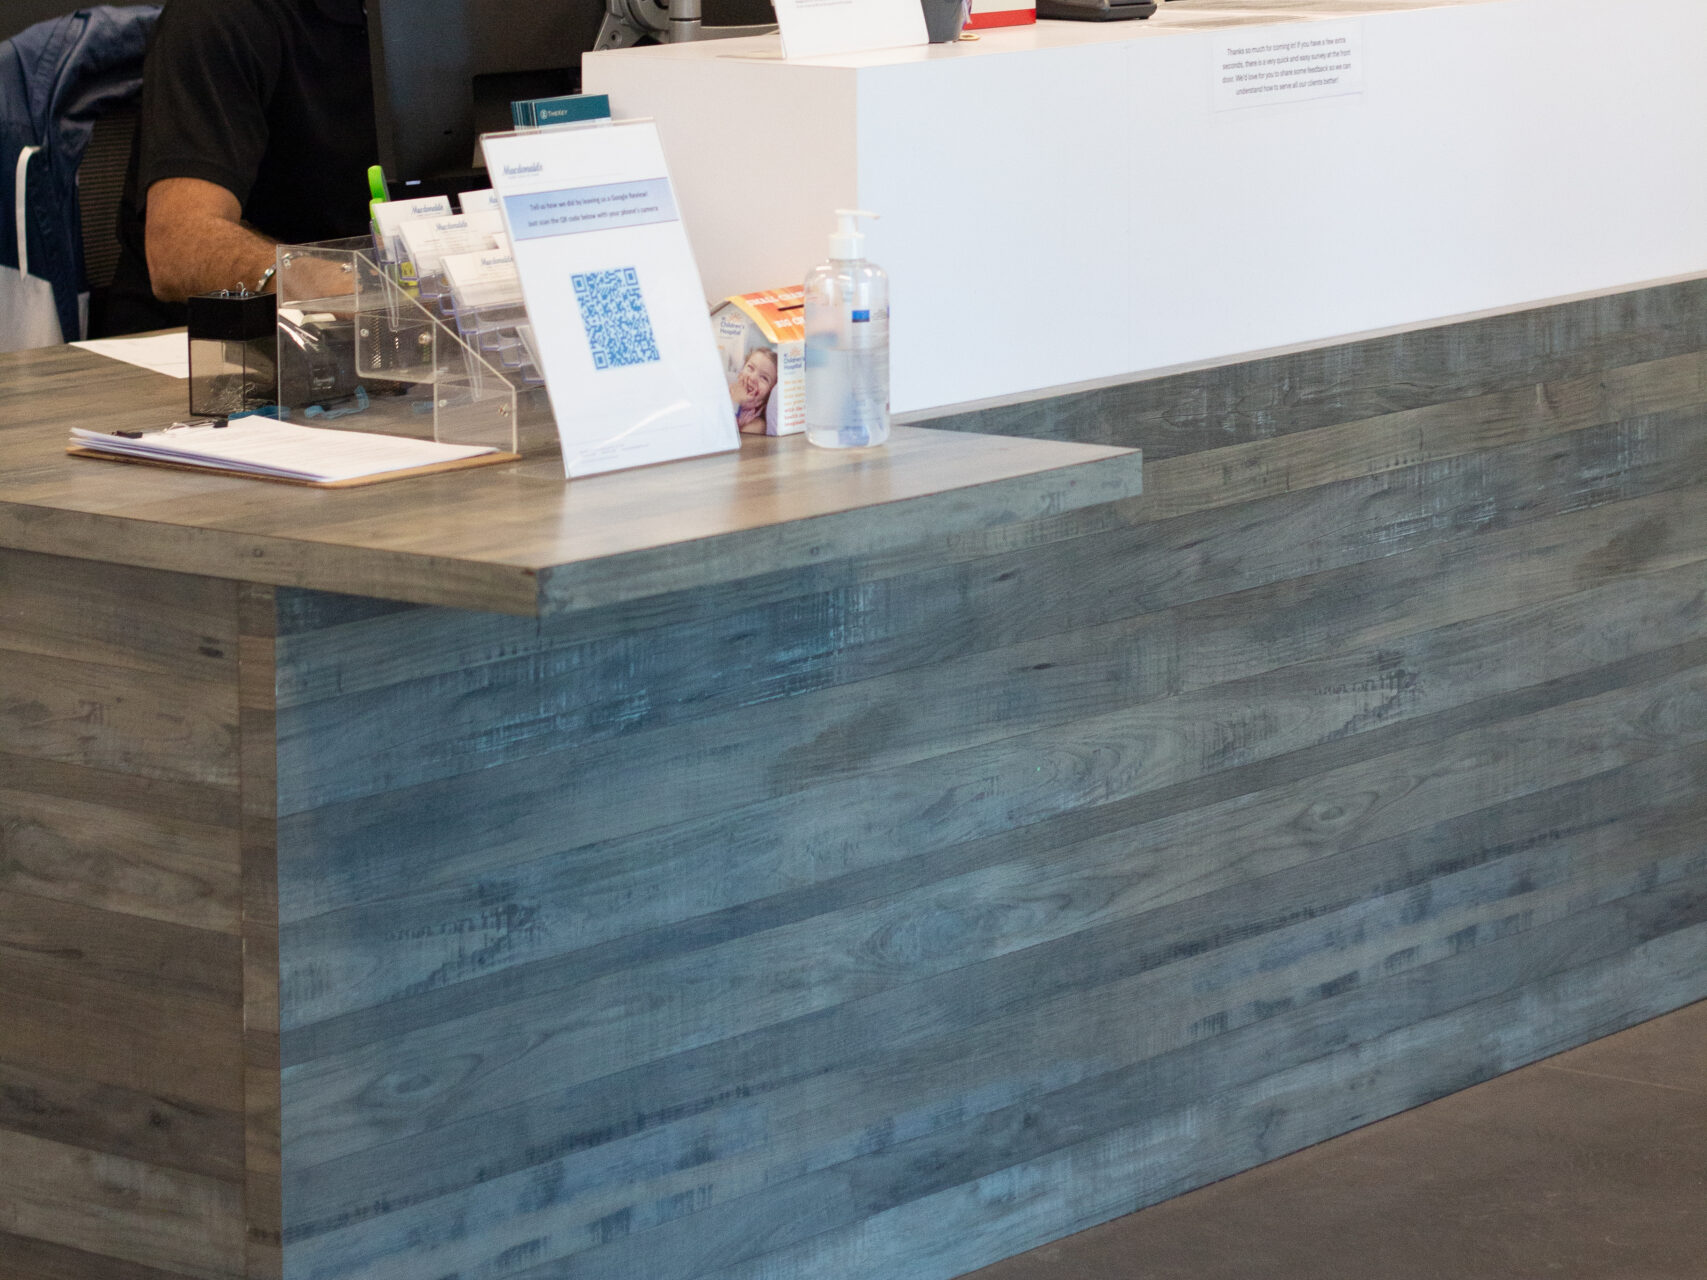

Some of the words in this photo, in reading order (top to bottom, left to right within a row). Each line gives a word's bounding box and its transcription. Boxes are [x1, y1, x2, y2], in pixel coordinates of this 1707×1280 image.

[1273, 43, 1290, 52] coming
[1277, 57, 1289, 65] quick
[1236, 86, 1263, 95] understand
[583, 197, 601, 207] leaving
[611, 195, 628, 204] Google
[551, 216, 559, 224] the
[560, 215, 567, 223] QR
[568, 214, 580, 222] code
[581, 212, 596, 220] below
[609, 211, 619, 219] your
